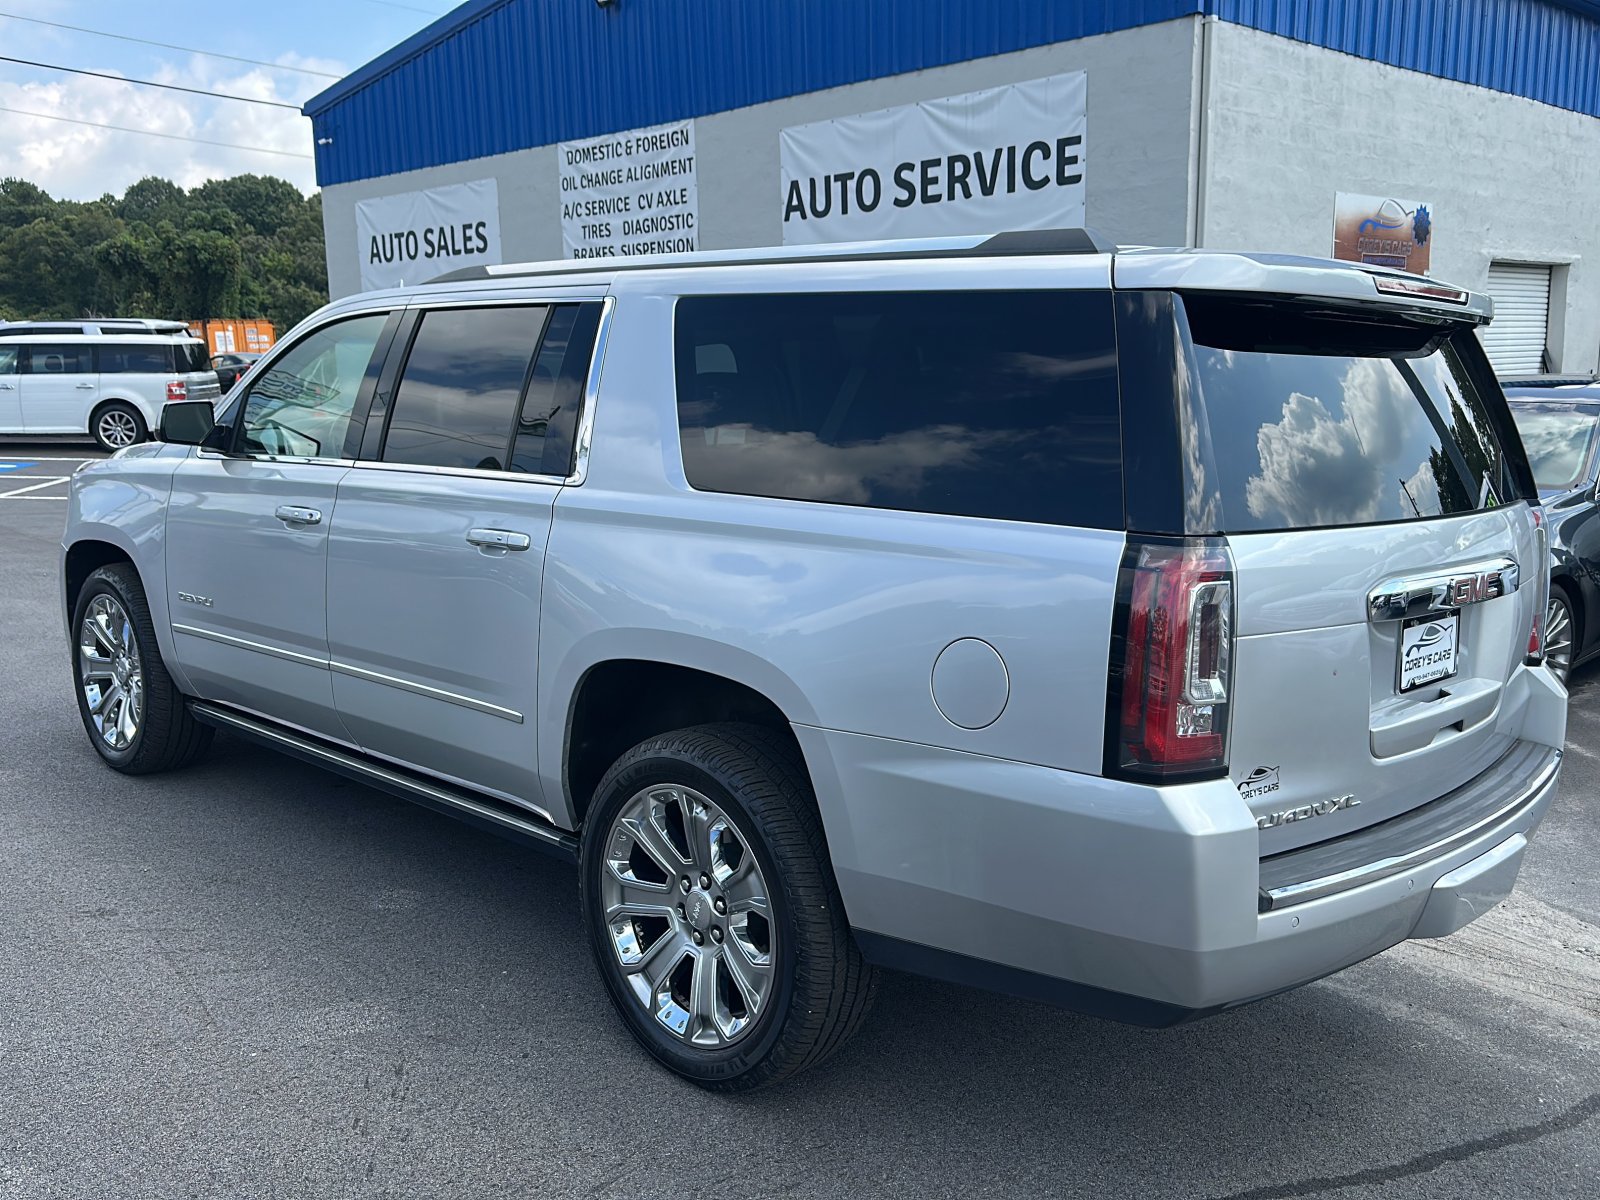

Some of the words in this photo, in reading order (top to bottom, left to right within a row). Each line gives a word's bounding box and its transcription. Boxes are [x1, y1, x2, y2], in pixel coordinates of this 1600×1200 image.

[566, 141, 622, 165] DOMESTIC
[625, 140, 633, 156] &
[636, 128, 689, 154] FOREIGN
[562, 176, 578, 192] OIL
[580, 169, 623, 189] CHANGE
[626, 157, 694, 183] ALIGNMENT
[783, 167, 881, 222] AUTO
[892, 135, 1083, 208] SERVICE
[563, 202, 582, 220] A/C
[585, 196, 630, 216] SERVICE
[638, 192, 653, 210] CV
[656, 188, 688, 208] AXLE
[582, 222, 611, 240] TIRES
[623, 212, 694, 235] DIAGNOSTIC
[370, 230, 418, 264] AUTO
[423, 221, 488, 259] SALES
[573, 245, 615, 259] BRAKES
[621, 237, 694, 256] SUSPENSION
[1451, 571, 1499, 605] GMC
[1404, 652, 1432, 672] COREY'S
[1432, 648, 1452, 664] CARS
[1240, 787, 1263, 800] OREY'S
[1263, 782, 1280, 794] CARS
[1255, 800, 1329, 831] UKON
